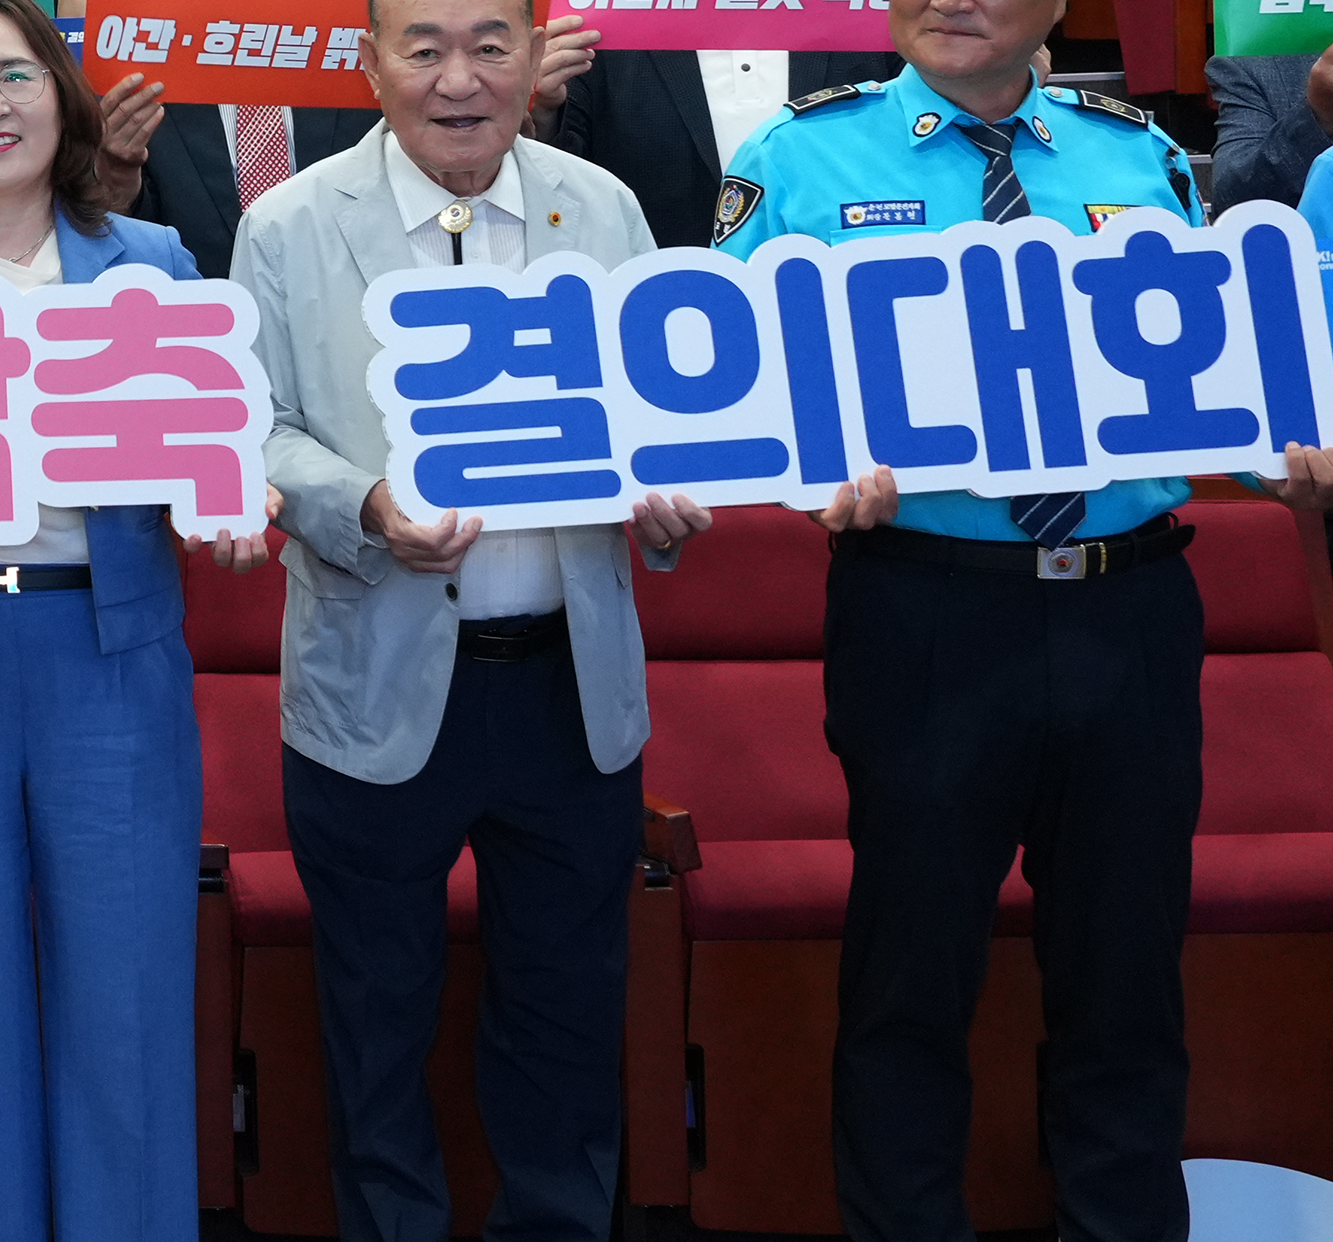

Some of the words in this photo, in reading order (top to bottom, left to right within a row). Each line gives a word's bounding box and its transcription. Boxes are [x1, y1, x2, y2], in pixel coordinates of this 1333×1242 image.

[96, 15, 176, 64] 야간
[196, 20, 317, 69] 흐린날
[389, 224, 1316, 506] 결의대회
